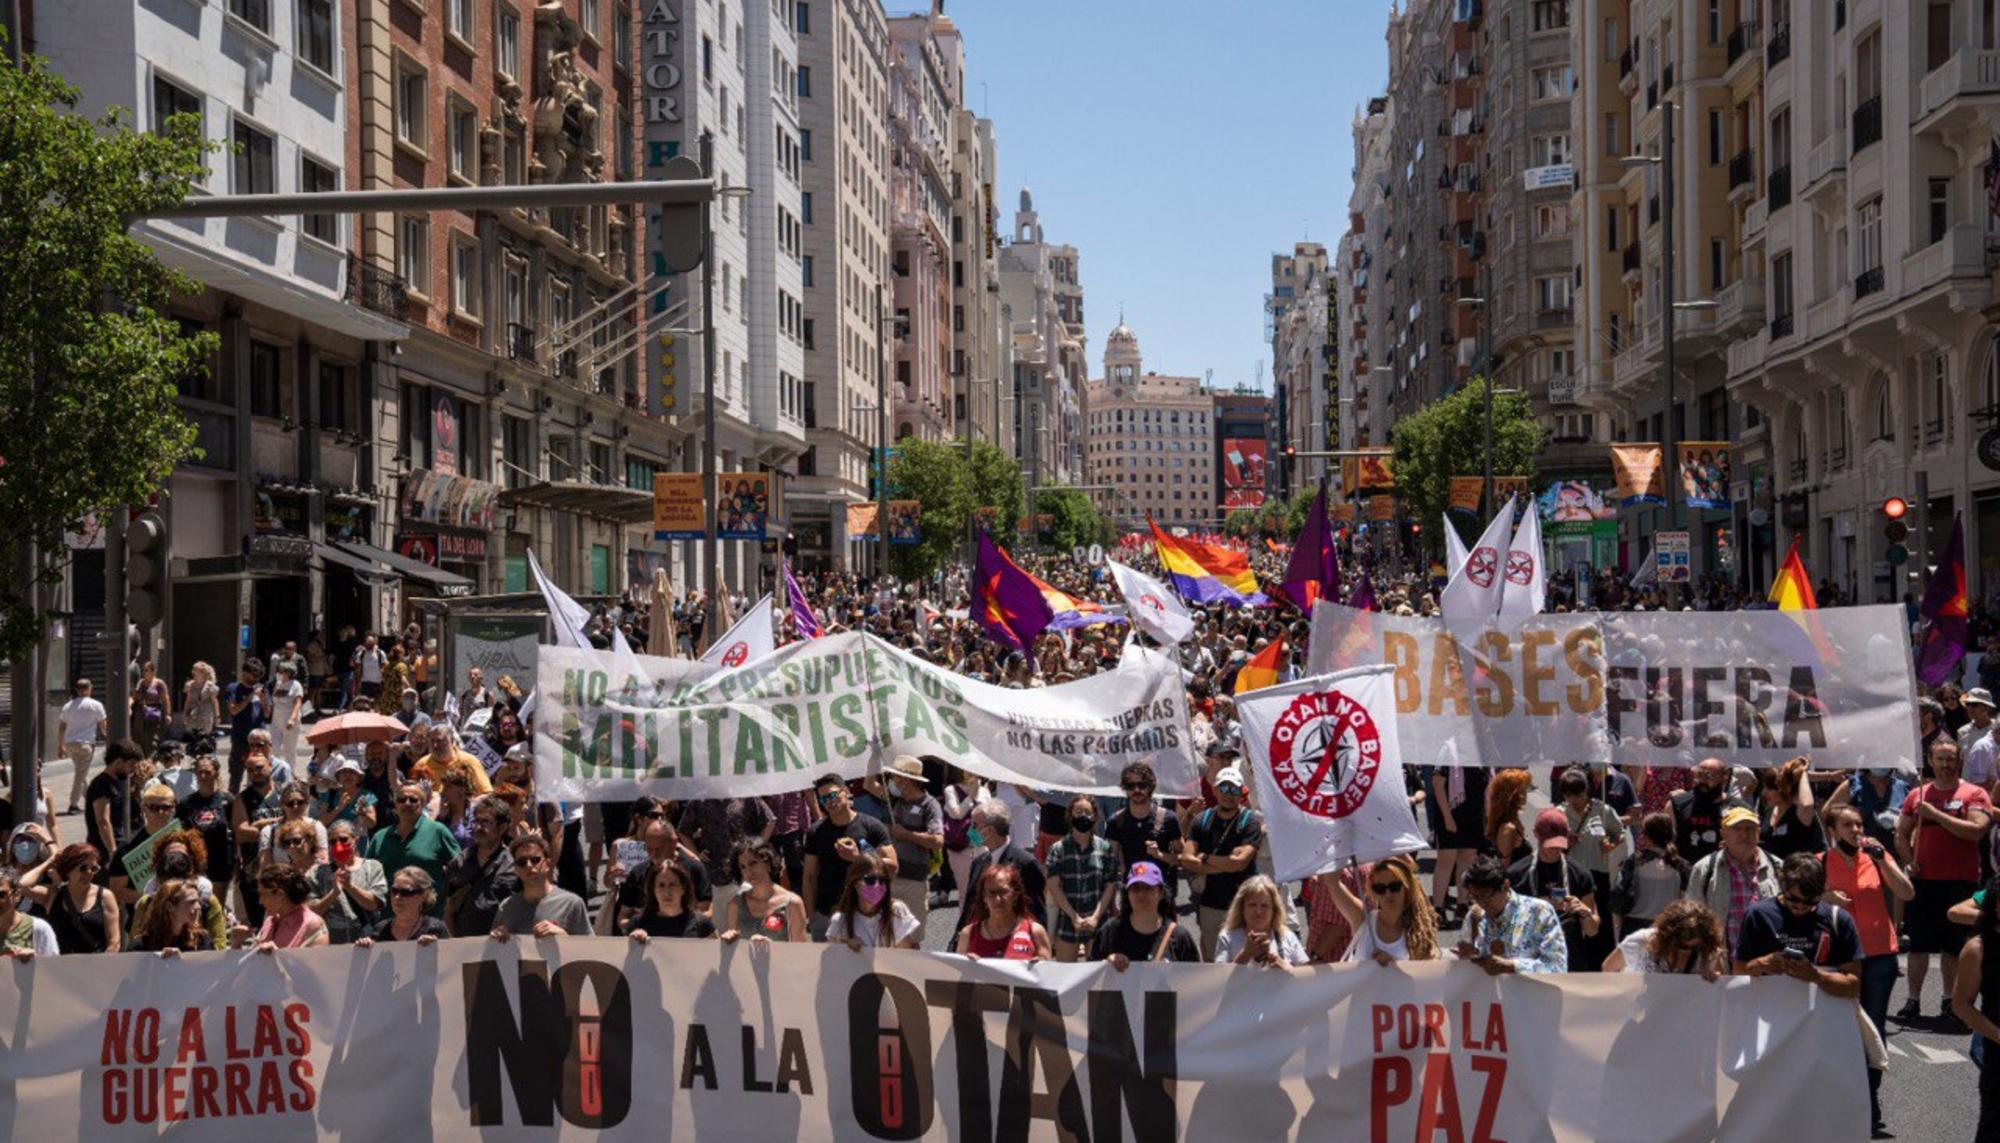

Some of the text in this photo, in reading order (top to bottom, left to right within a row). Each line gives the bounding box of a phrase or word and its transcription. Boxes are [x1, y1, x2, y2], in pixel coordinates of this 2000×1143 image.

[645, 0, 681, 123] ATOR
[562, 685, 970, 779] MILITARISTAS
[563, 668, 608, 706] NO
[618, 673, 641, 706] A
[1383, 628, 1827, 750] BASES FUERA
[1006, 724, 1180, 755] NO LAS PAGAMOS
[1274, 697, 1378, 814] OTAN NO BASES FUERA
[101, 1002, 312, 1066] NO A LAS
[462, 958, 1179, 1143] NO A LA OTAN
[1371, 1001, 1508, 1053] POR LA
[102, 1058, 317, 1126] GUERRAS
[1370, 1051, 1508, 1143] PAZ
